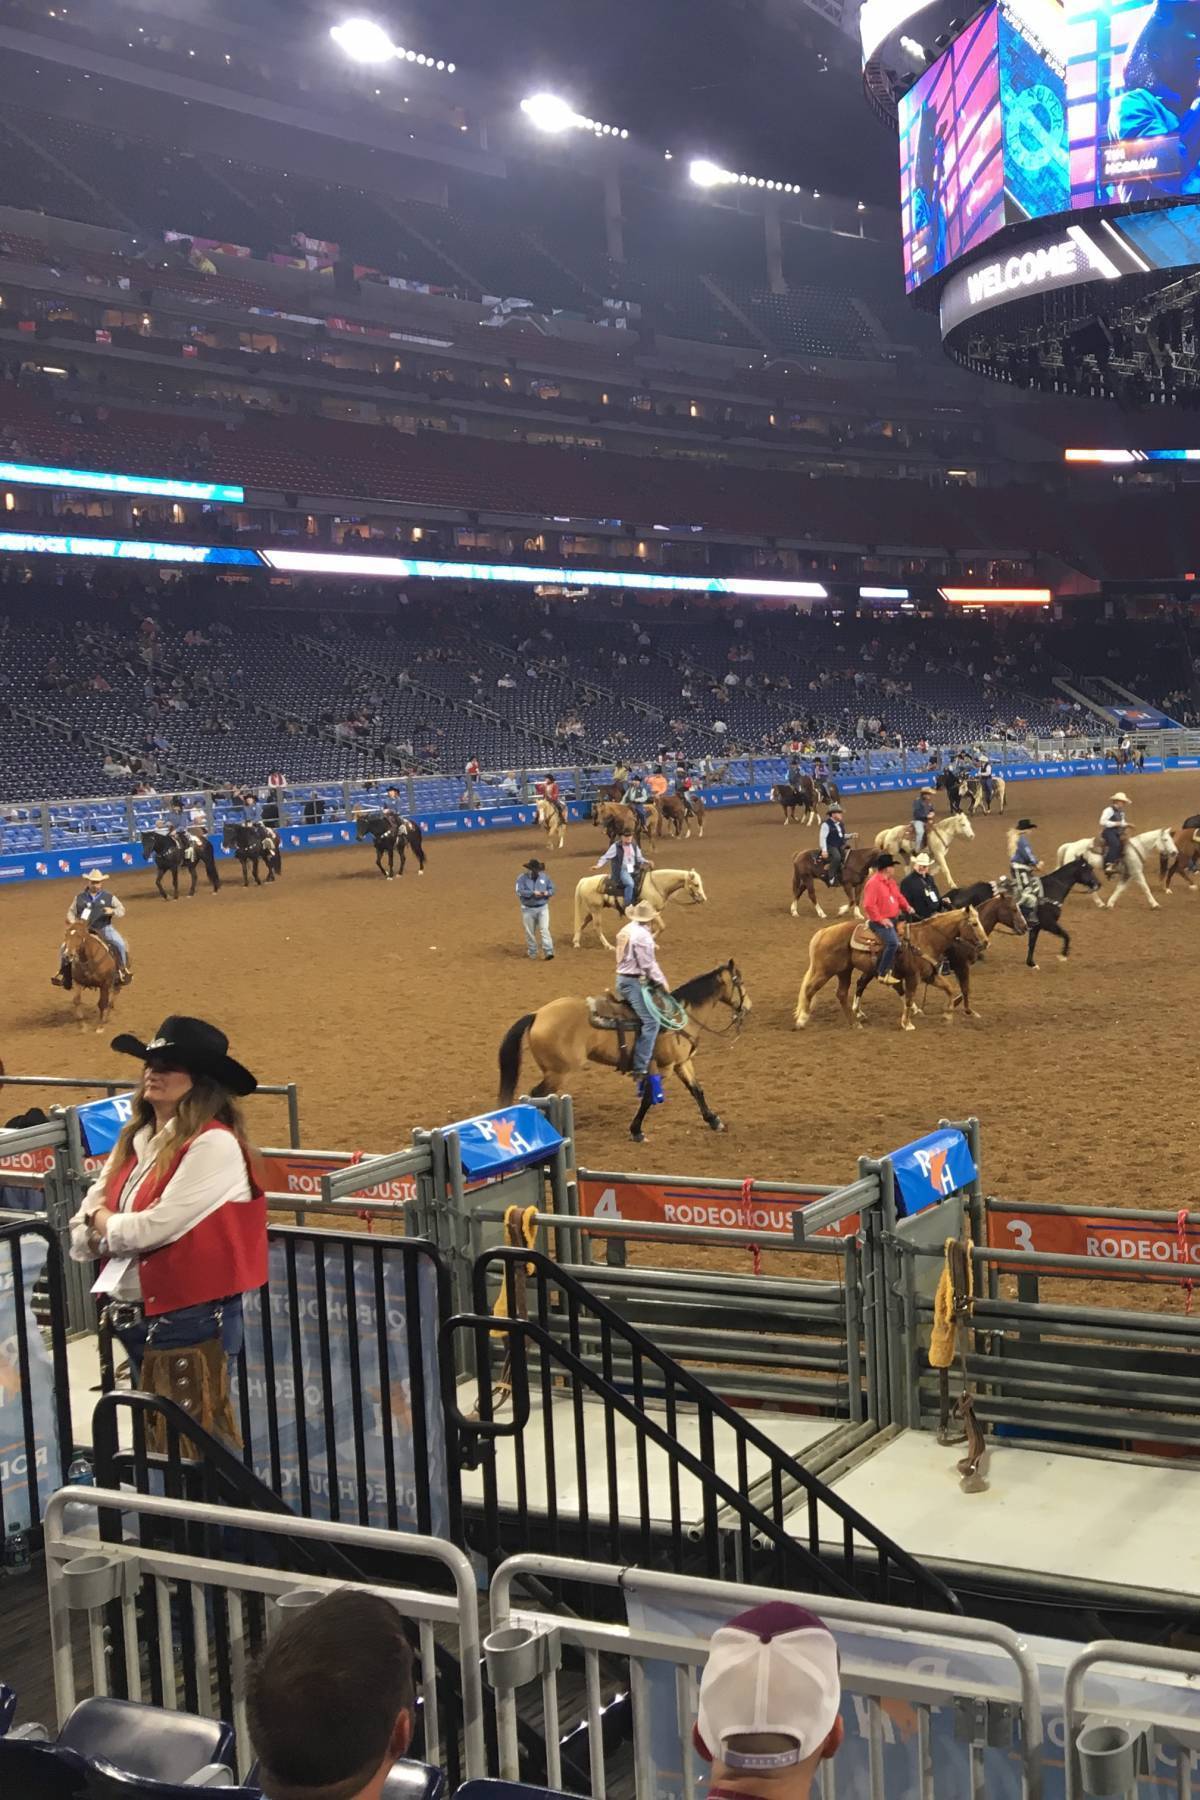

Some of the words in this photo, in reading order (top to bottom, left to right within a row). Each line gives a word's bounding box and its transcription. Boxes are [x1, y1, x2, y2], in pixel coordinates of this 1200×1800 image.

[967, 240, 1078, 304] WELCOME
[594, 1188, 622, 1221] 4
[1006, 1219, 1034, 1252] 3
